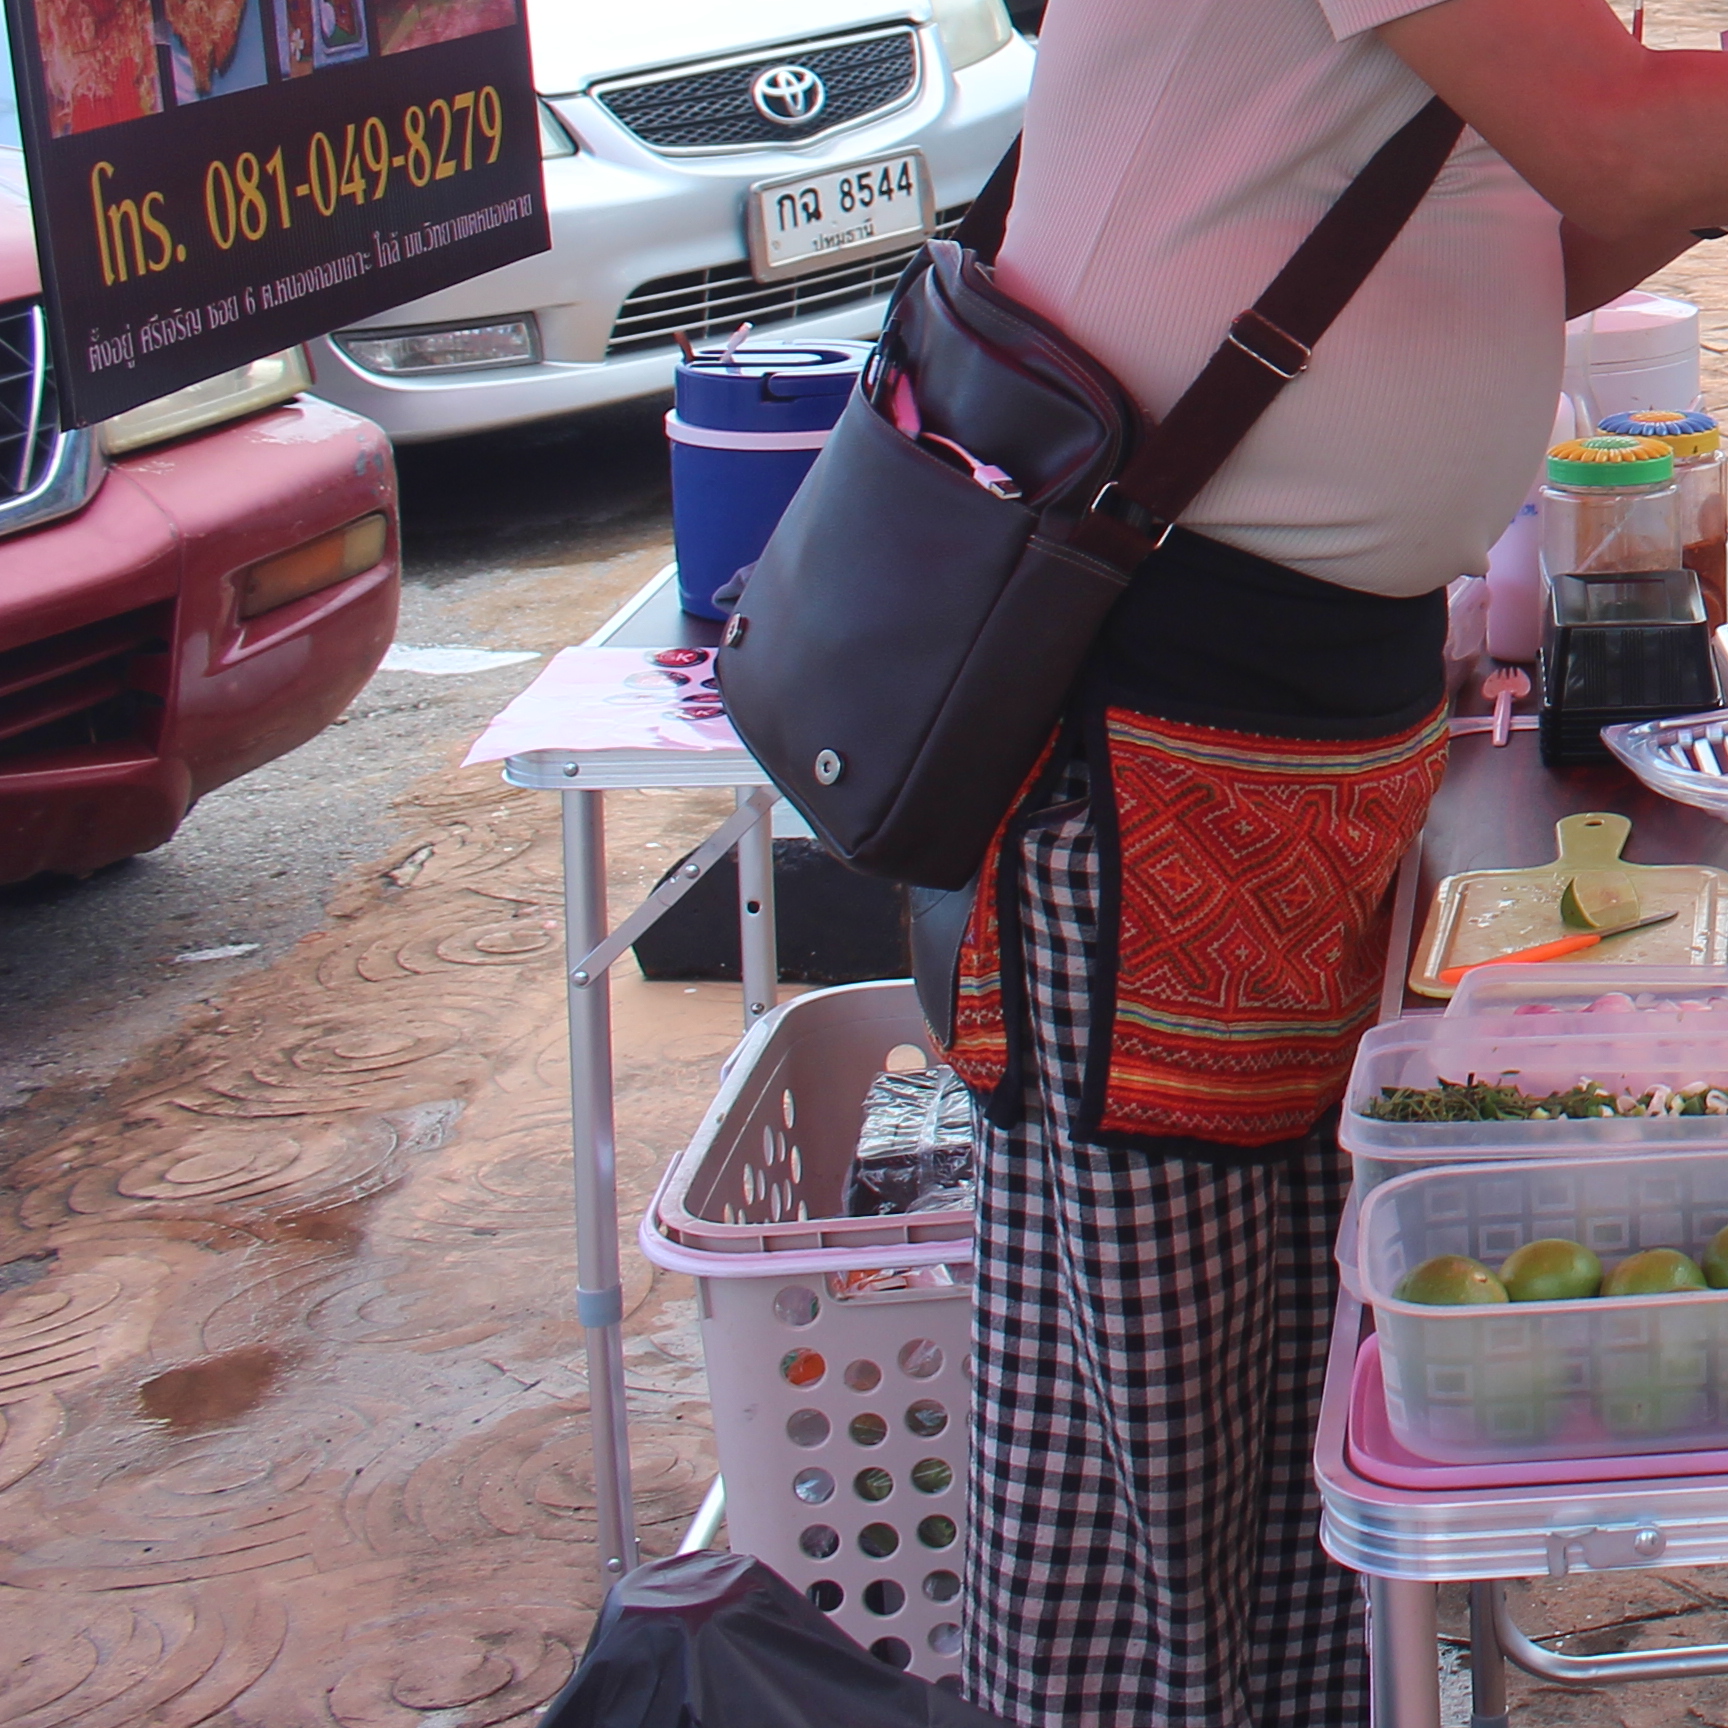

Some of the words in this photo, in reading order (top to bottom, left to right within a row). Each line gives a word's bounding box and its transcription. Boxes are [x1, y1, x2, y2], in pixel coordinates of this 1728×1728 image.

[90, 160, 187, 287] โทร.
[204, 84, 504, 251] 081-049-8279
[838, 160, 914, 213] 8544
[88, 324, 136, 373] ตั้งอยู่
[209, 295, 240, 330] ซอย
[245, 287, 256, 315] 6
[373, 230, 401, 268] ใกล้
